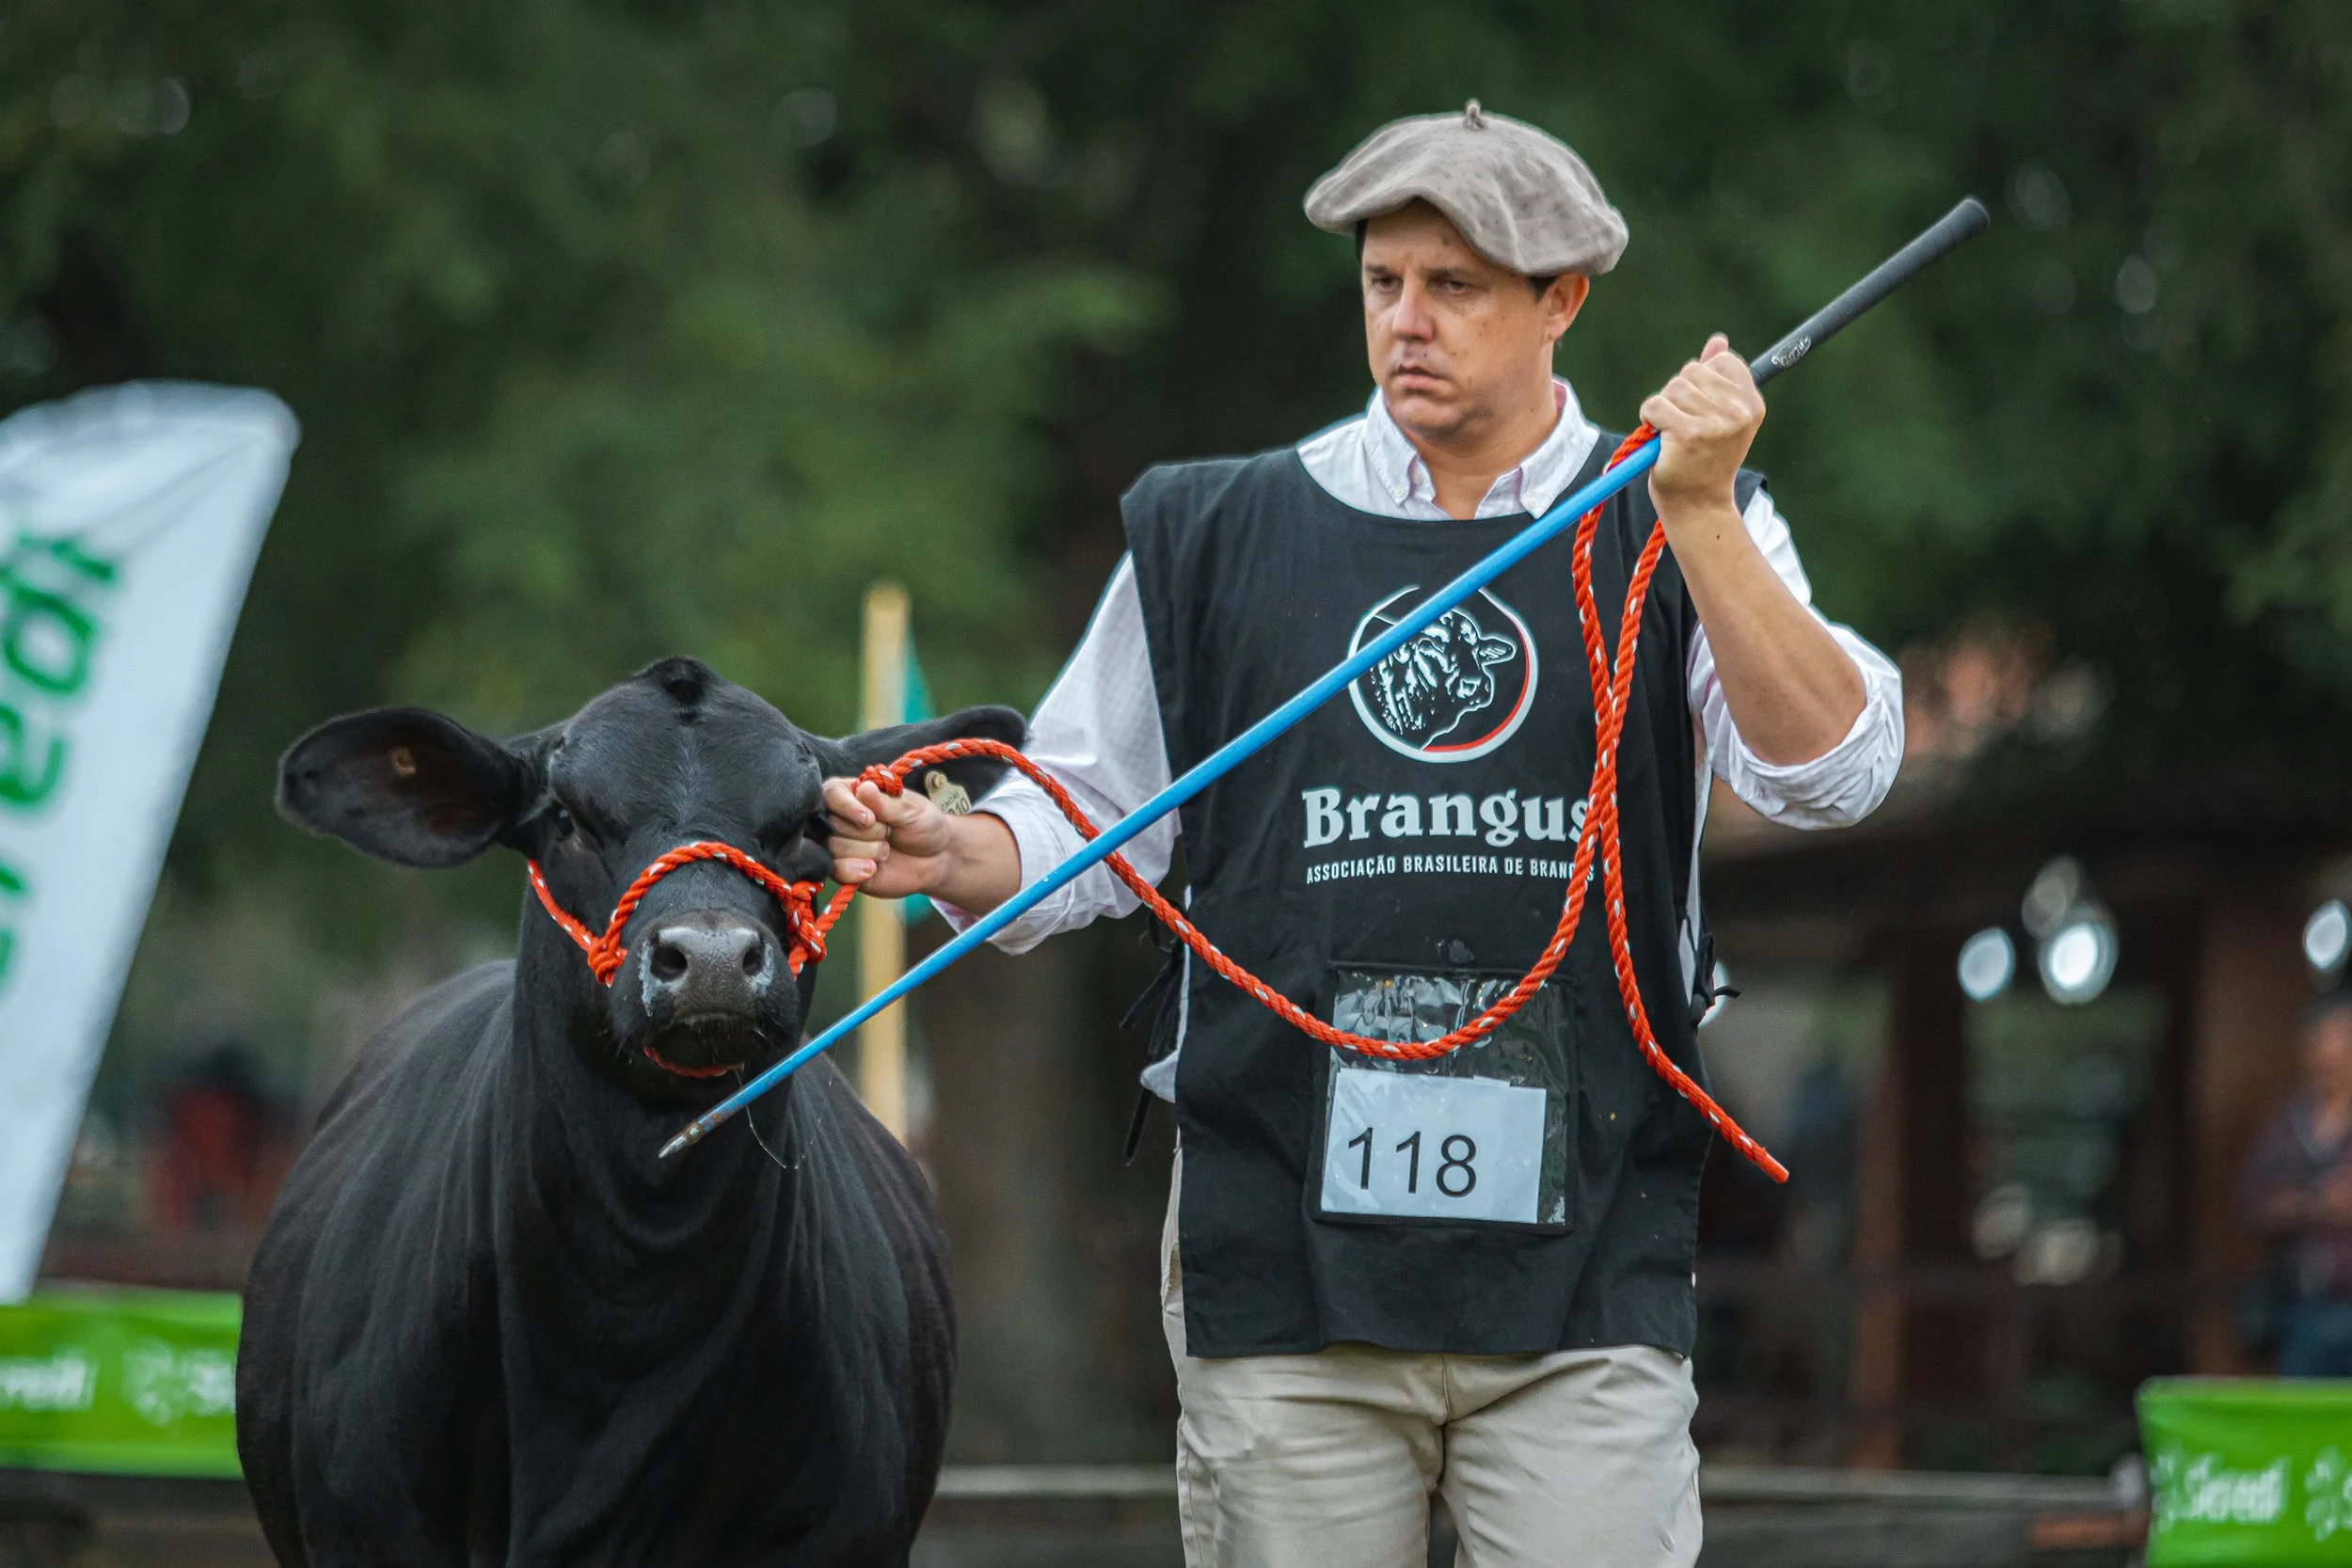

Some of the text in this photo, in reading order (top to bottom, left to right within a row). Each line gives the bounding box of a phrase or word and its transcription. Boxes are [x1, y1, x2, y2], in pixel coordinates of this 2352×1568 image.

[1306, 854, 1596, 885] ASSOCIAÇÃO BRASILEIRA DE BRANS
[1348, 1126, 1478, 1199] 118
